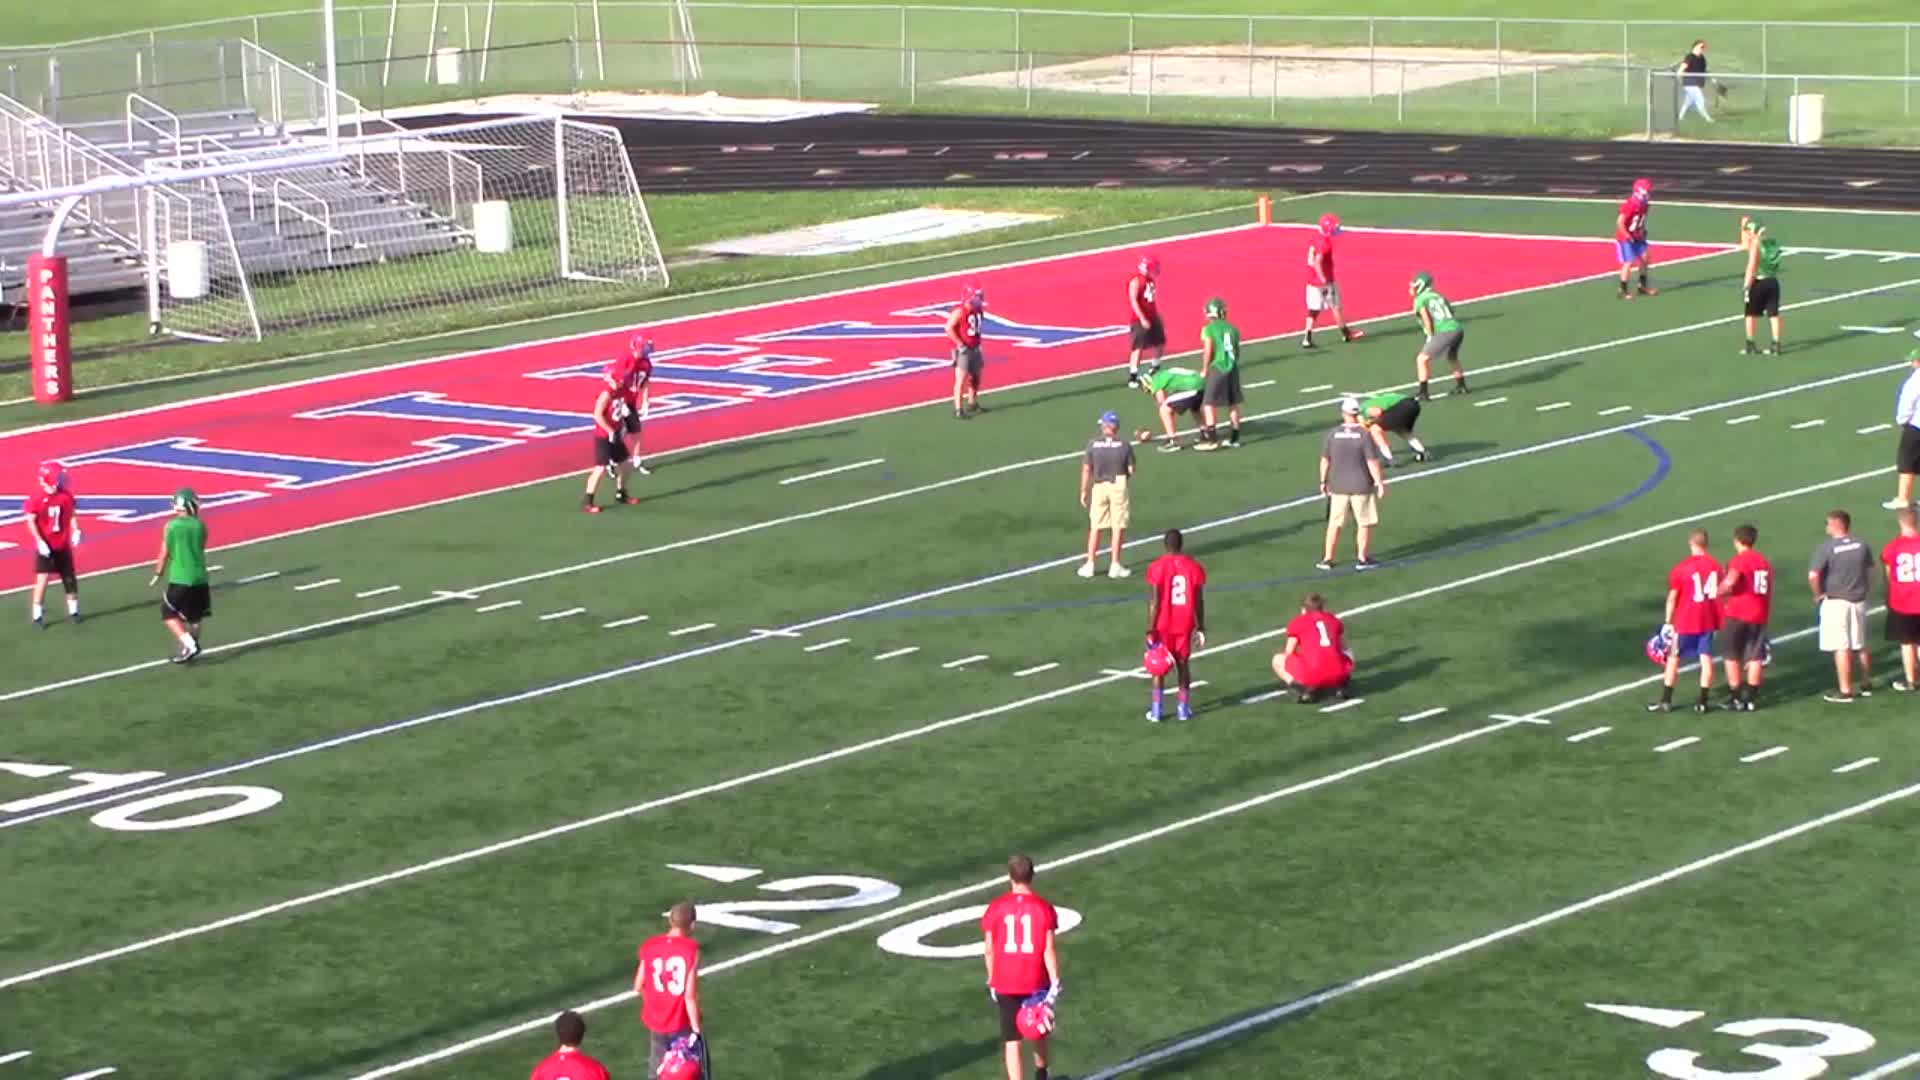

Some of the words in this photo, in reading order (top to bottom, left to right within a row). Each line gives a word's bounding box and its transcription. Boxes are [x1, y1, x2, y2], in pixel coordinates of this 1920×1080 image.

[40, 269, 59, 395] PANTHERS
[48, 505, 61, 532] 7
[1171, 574, 1186, 605] 2
[1692, 571, 1717, 602] 14
[1753, 569, 1768, 595] 15
[1316, 620, 1331, 647] 1
[1004, 913, 1034, 953] 11
[652, 955, 686, 996] 13
